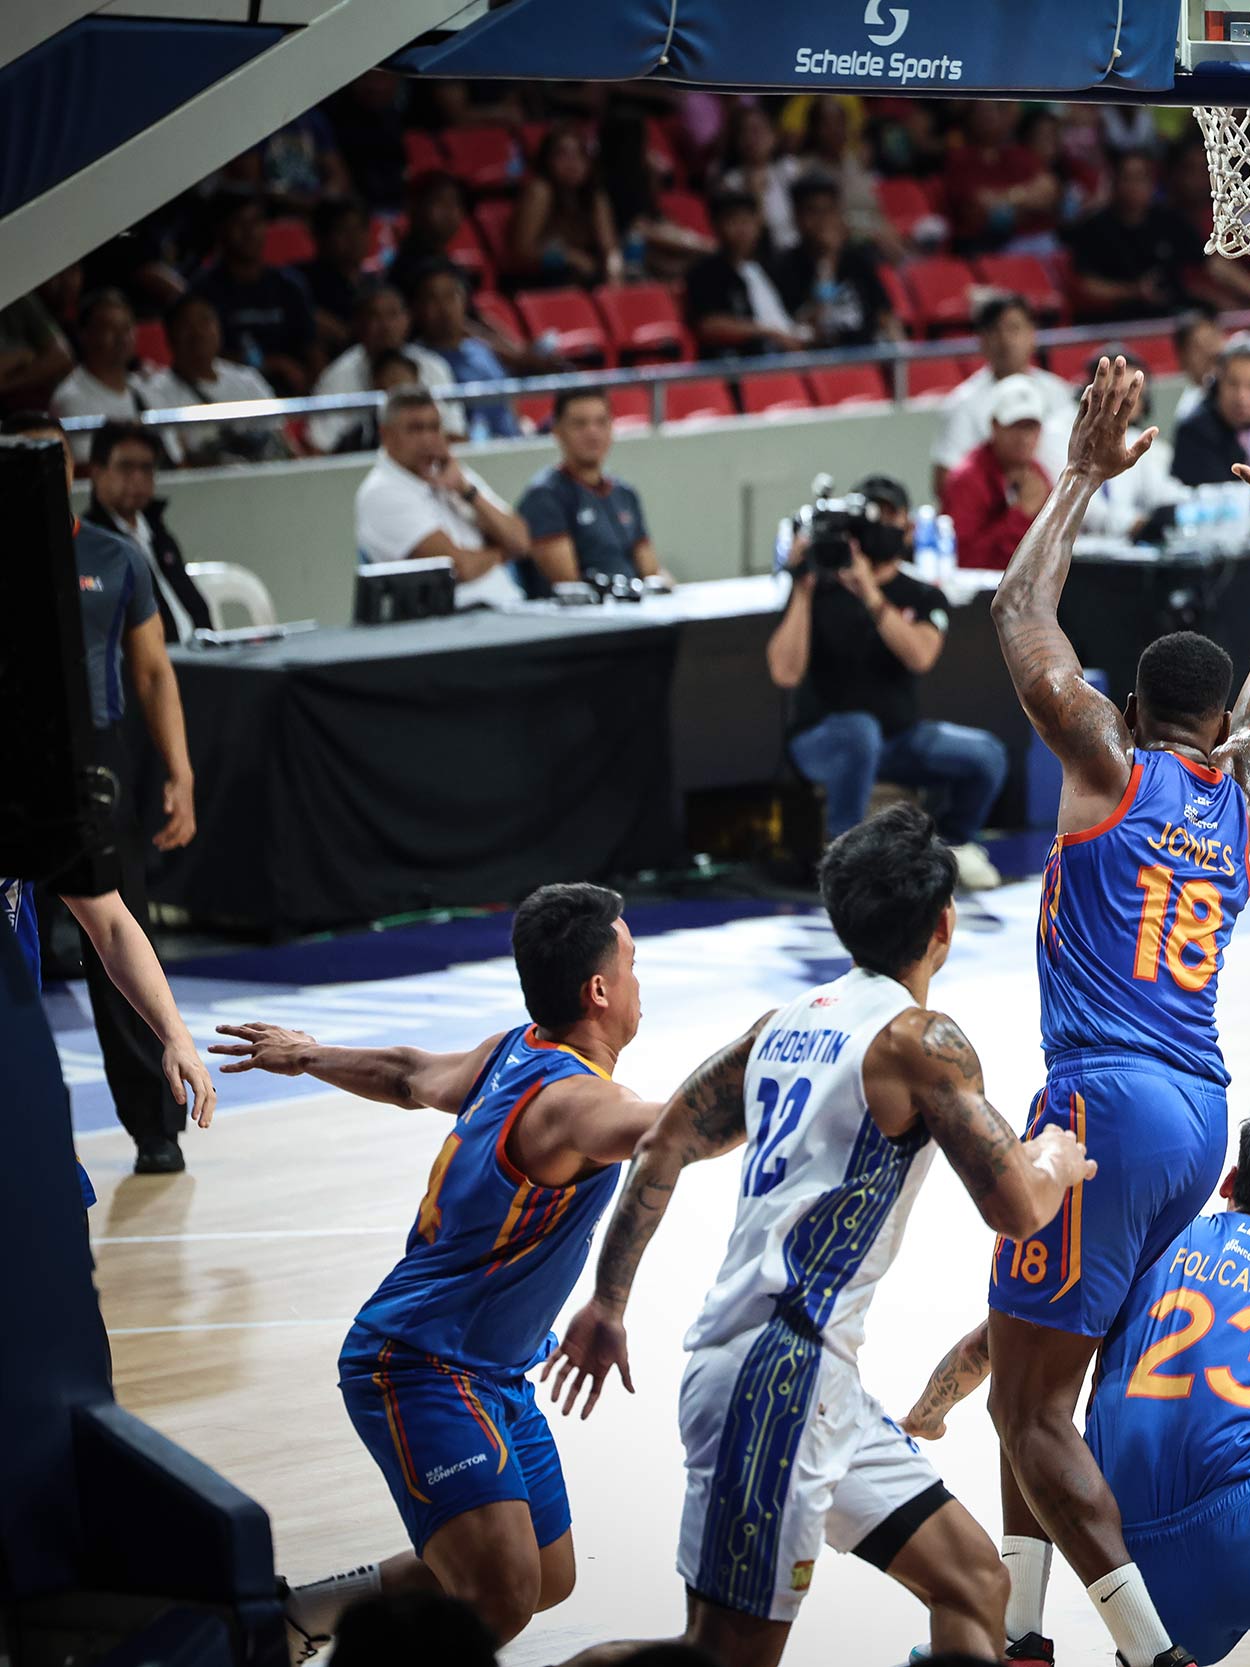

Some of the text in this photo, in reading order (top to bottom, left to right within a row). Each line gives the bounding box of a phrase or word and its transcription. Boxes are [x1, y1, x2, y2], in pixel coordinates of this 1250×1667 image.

[795, 48, 963, 85] Schelde Sports
[1147, 822, 1235, 877] JONES
[1133, 863, 1225, 993] 18
[1009, 1238, 1049, 1285] 18
